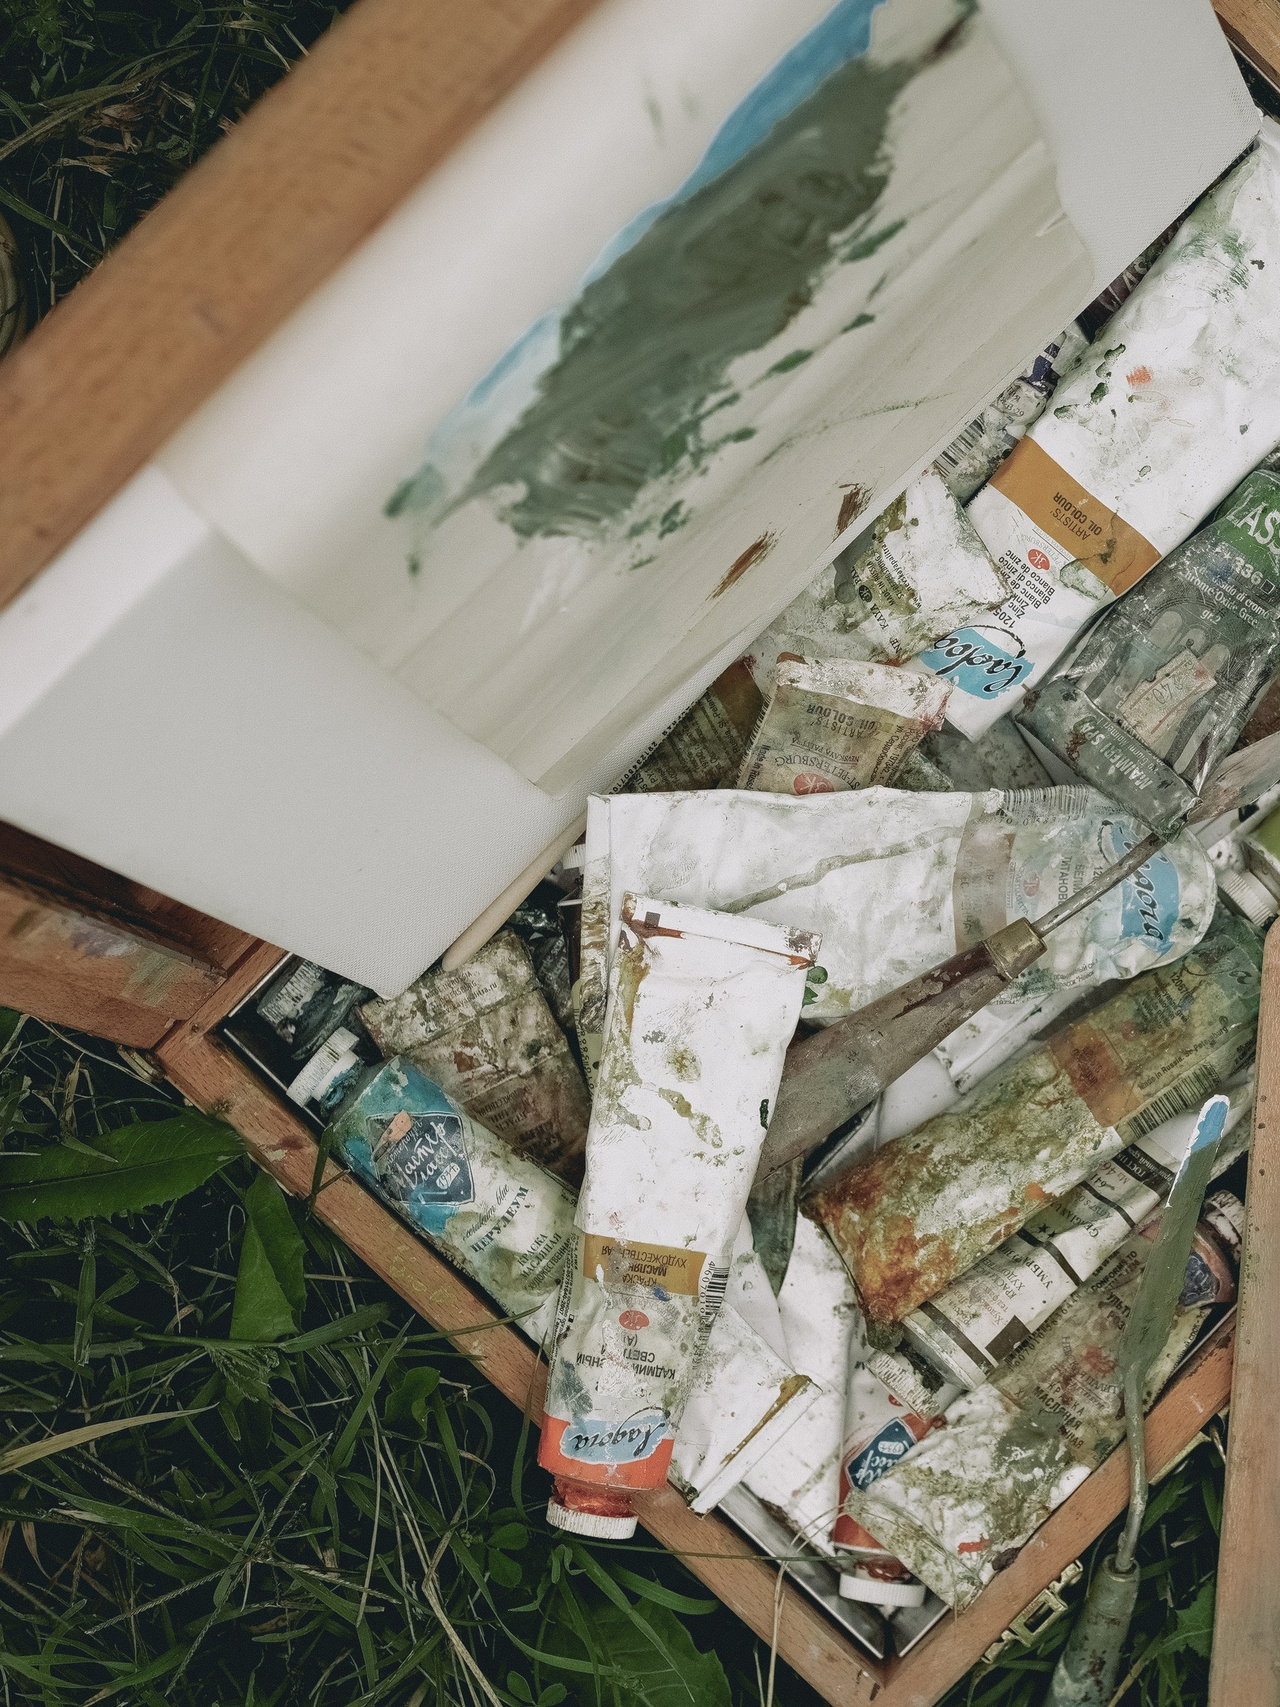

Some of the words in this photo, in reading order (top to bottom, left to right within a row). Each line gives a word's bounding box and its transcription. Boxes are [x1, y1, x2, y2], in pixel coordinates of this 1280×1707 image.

[1051, 491, 1089, 524] COLOUR
[1048, 505, 1091, 541] ARTISTS'
[1085, 518, 1103, 536] OIL
[1003, 549, 1022, 566] zinc
[1022, 579, 1051, 604] Bianco
[1028, 570, 1056, 595] Blanco
[1005, 601, 1025, 618] Zinc
[1017, 586, 1042, 609] Blanc
[1236, 605, 1263, 628] Gree
[1078, 720, 1106, 748] SPA
[1099, 740, 1153, 791] MAIMERI
[469, 1186, 529, 1251] ЦЕРУЛЕУМ
[516, 1231, 548, 1267] КРАСКА
[519, 1231, 562, 1280] МАСЛЯНАЯ
[626, 1261, 667, 1276] МАСЛЯН
